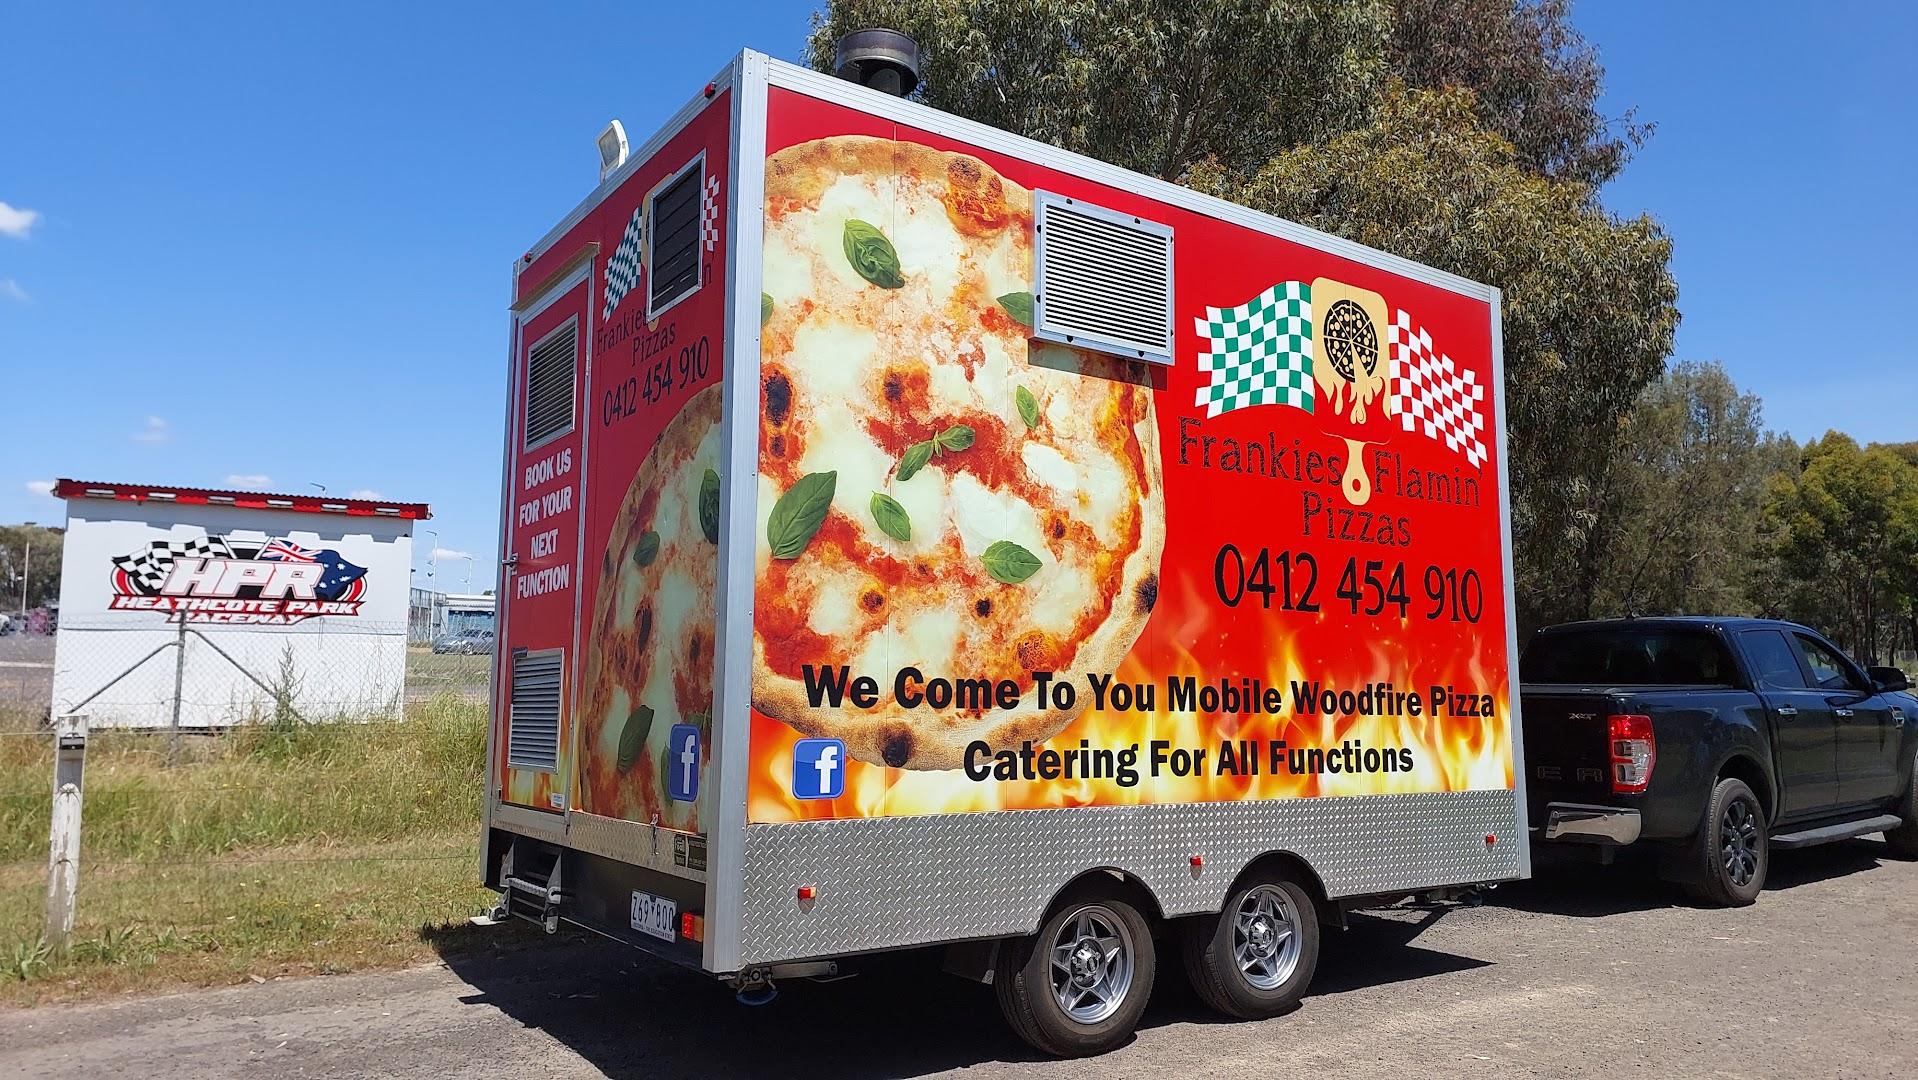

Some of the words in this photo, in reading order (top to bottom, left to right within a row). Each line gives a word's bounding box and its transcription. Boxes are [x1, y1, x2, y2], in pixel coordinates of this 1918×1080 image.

[632, 321, 676, 367] Pizzas
[604, 377, 637, 427] 0412
[642, 355, 673, 405] 454
[679, 336, 709, 389] 910
[524, 455, 554, 490] BOOK
[556, 447, 572, 476] US
[1178, 415, 1342, 486] Frankies
[519, 498, 540, 528] FOR
[542, 486, 572, 519] YOUR
[1301, 490, 1412, 547] Pizzas
[530, 528, 558, 560] NEXT
[160, 557, 326, 600] HPR
[517, 564, 570, 600] FUNCTION
[1214, 543, 1321, 614] 0412
[1337, 556, 1411, 619] 454
[1424, 565, 1483, 624] 910
[115, 596, 281, 613] HEATHCOTE
[285, 600, 356, 616] PARK
[802, 664, 879, 708] We
[894, 666, 1020, 710] Come
[1032, 672, 1076, 710] To
[1087, 673, 1155, 712] You
[1168, 675, 1281, 714] Mobile
[1291, 680, 1422, 717] Woodfire
[1430, 686, 1495, 718] Pizza
[963, 740, 1139, 787] Catering
[1151, 740, 1206, 778] For
[1216, 740, 1258, 776] All
[1271, 740, 1414, 775] Functions
